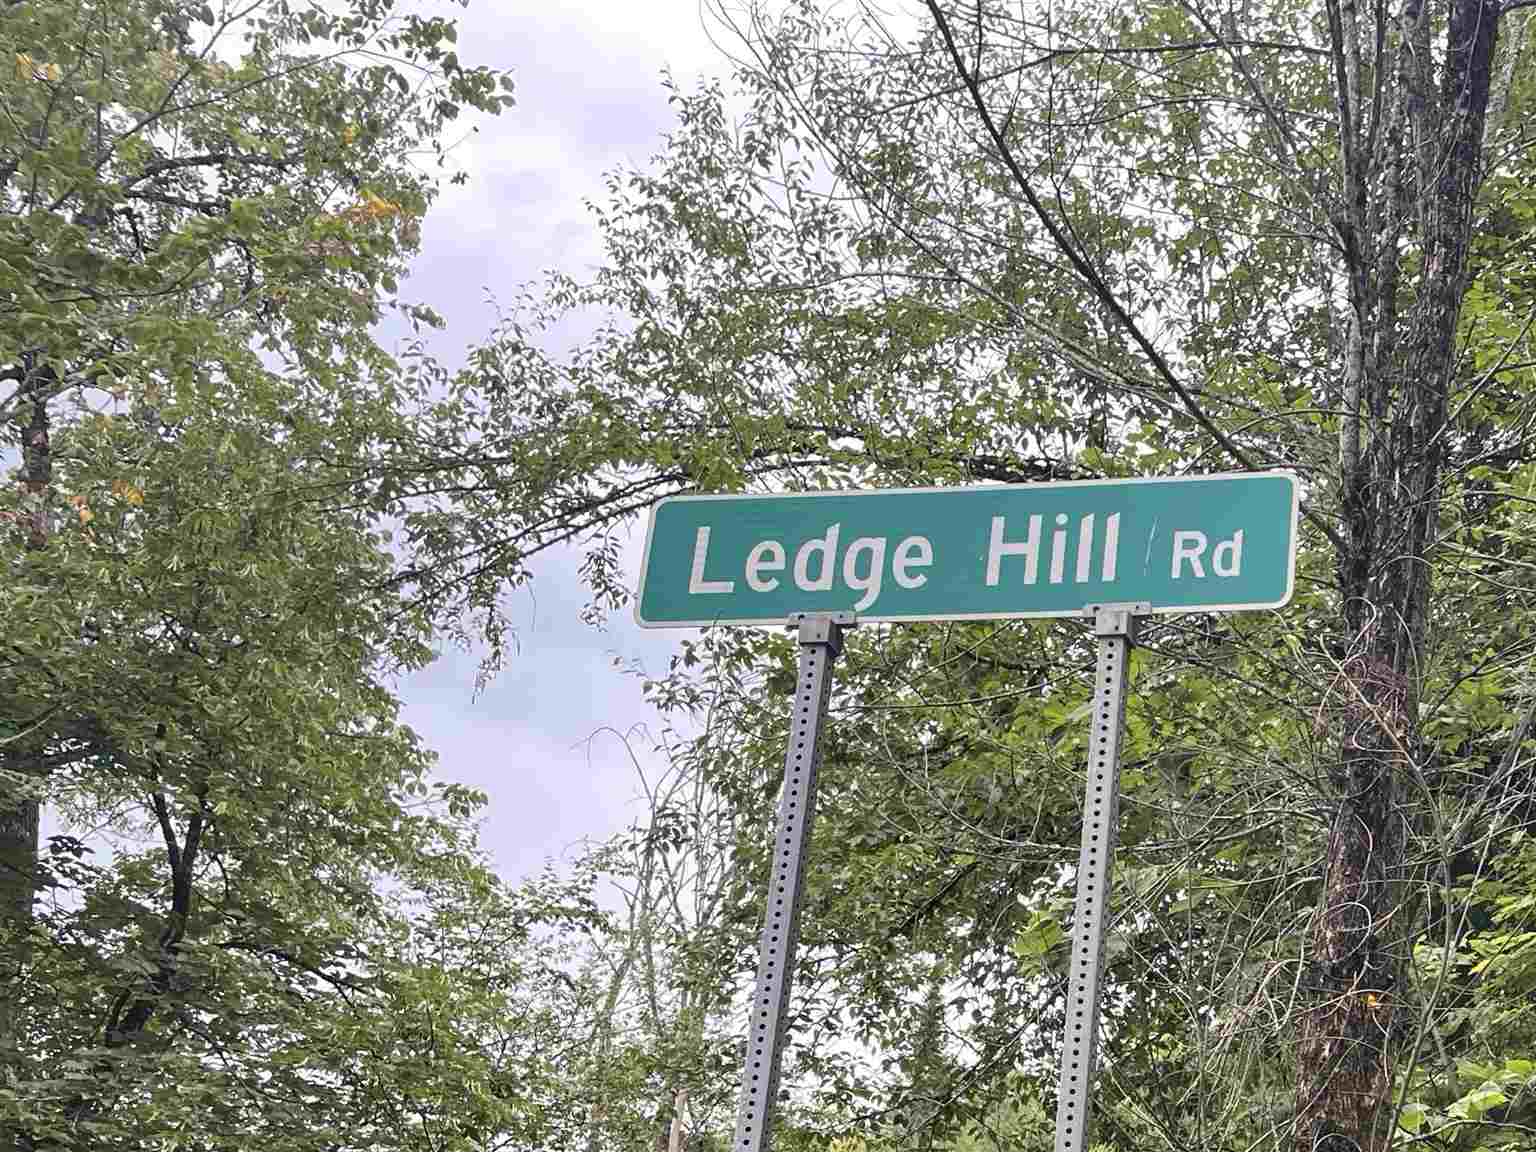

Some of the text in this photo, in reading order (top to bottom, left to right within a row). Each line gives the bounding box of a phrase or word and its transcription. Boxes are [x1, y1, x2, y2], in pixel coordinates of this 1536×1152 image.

[688, 512, 1244, 612] Ledge Hill Rd
